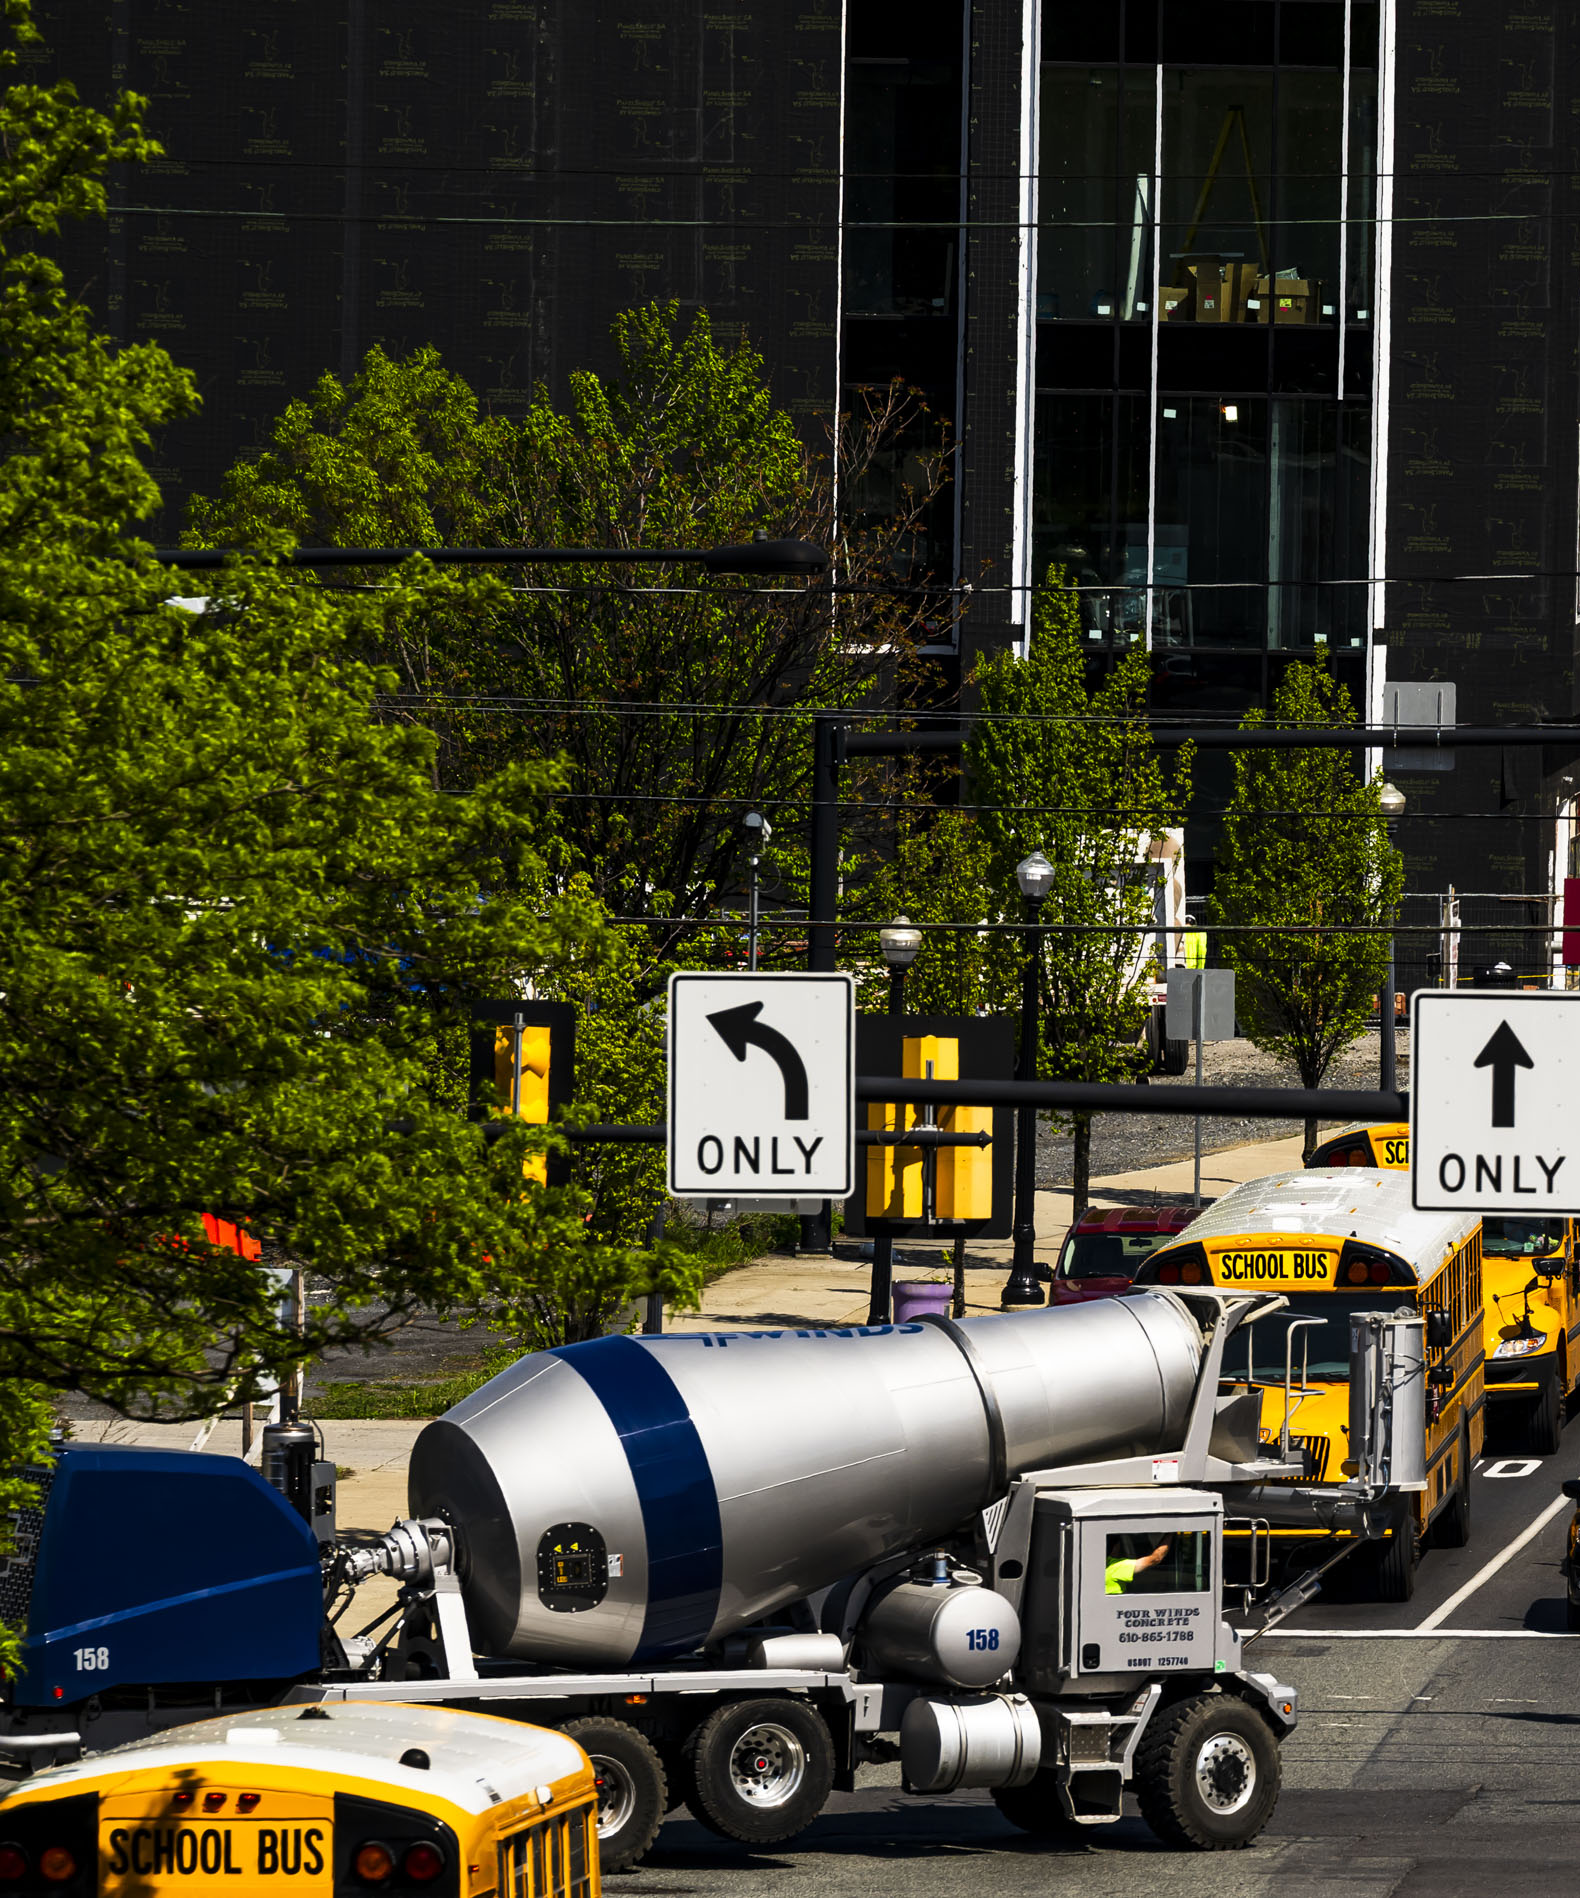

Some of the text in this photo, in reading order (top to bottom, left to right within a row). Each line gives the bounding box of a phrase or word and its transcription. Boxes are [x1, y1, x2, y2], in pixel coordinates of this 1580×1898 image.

[697, 1135, 824, 1177] ONLY
[1439, 1153, 1567, 1194] ONLY
[1221, 1252, 1328, 1280] SCHOOL BUS
[1116, 1608, 1200, 1619] FOUR WINDS
[1125, 1617, 1189, 1628] CONCRETE
[965, 1628, 1000, 1652] 158
[1119, 1630, 1194, 1643] 610-865-1788
[73, 1647, 110, 1672] 158
[108, 1827, 326, 1878] SCHOOL BUS
